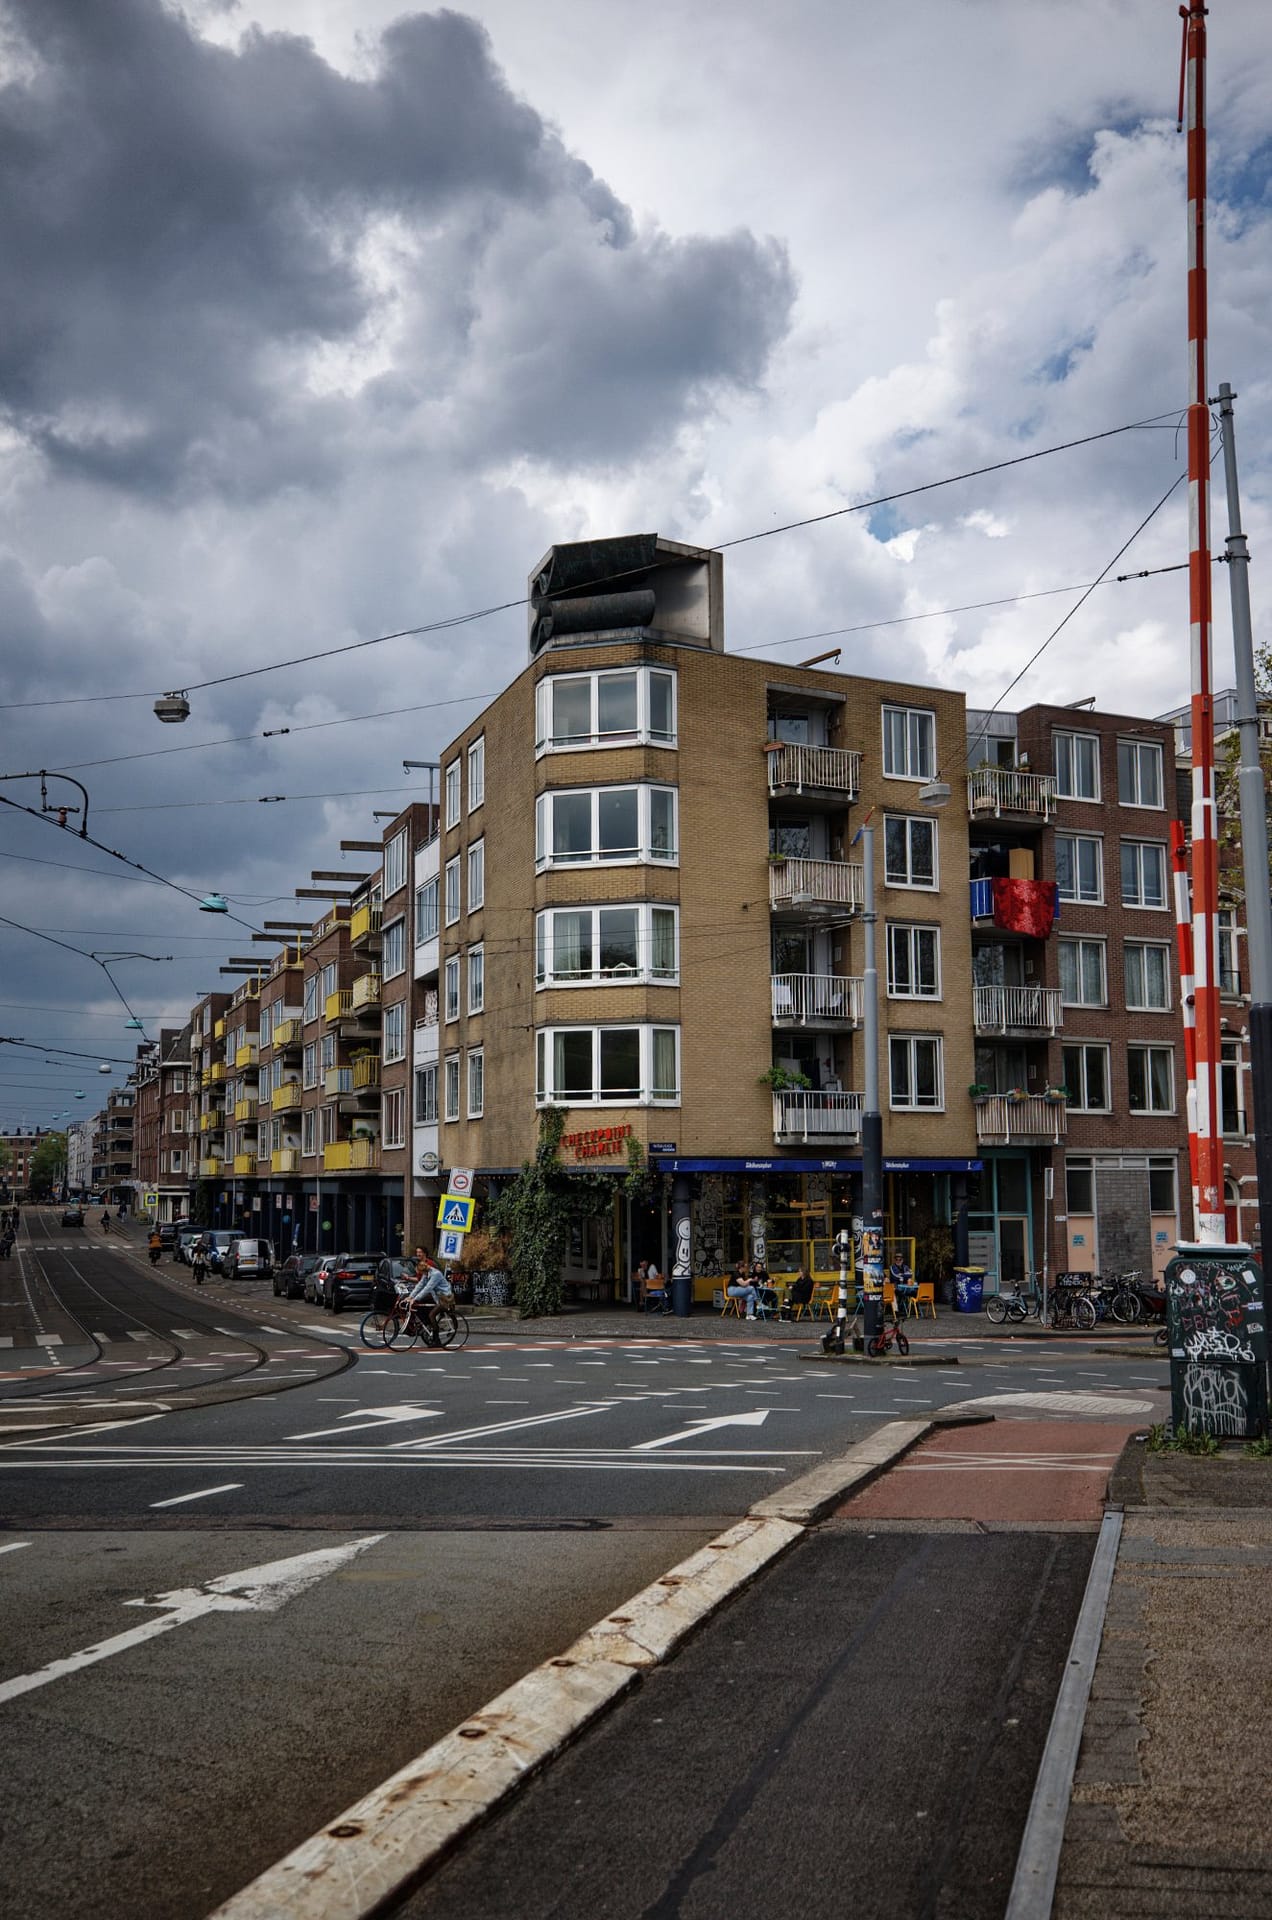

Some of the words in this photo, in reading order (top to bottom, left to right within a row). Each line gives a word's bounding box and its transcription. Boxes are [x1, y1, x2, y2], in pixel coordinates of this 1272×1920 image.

[560, 1124, 631, 1148] CHECKPOINT
[574, 1140, 622, 1158] CHARLIE
[447, 1237, 455, 1247] P
